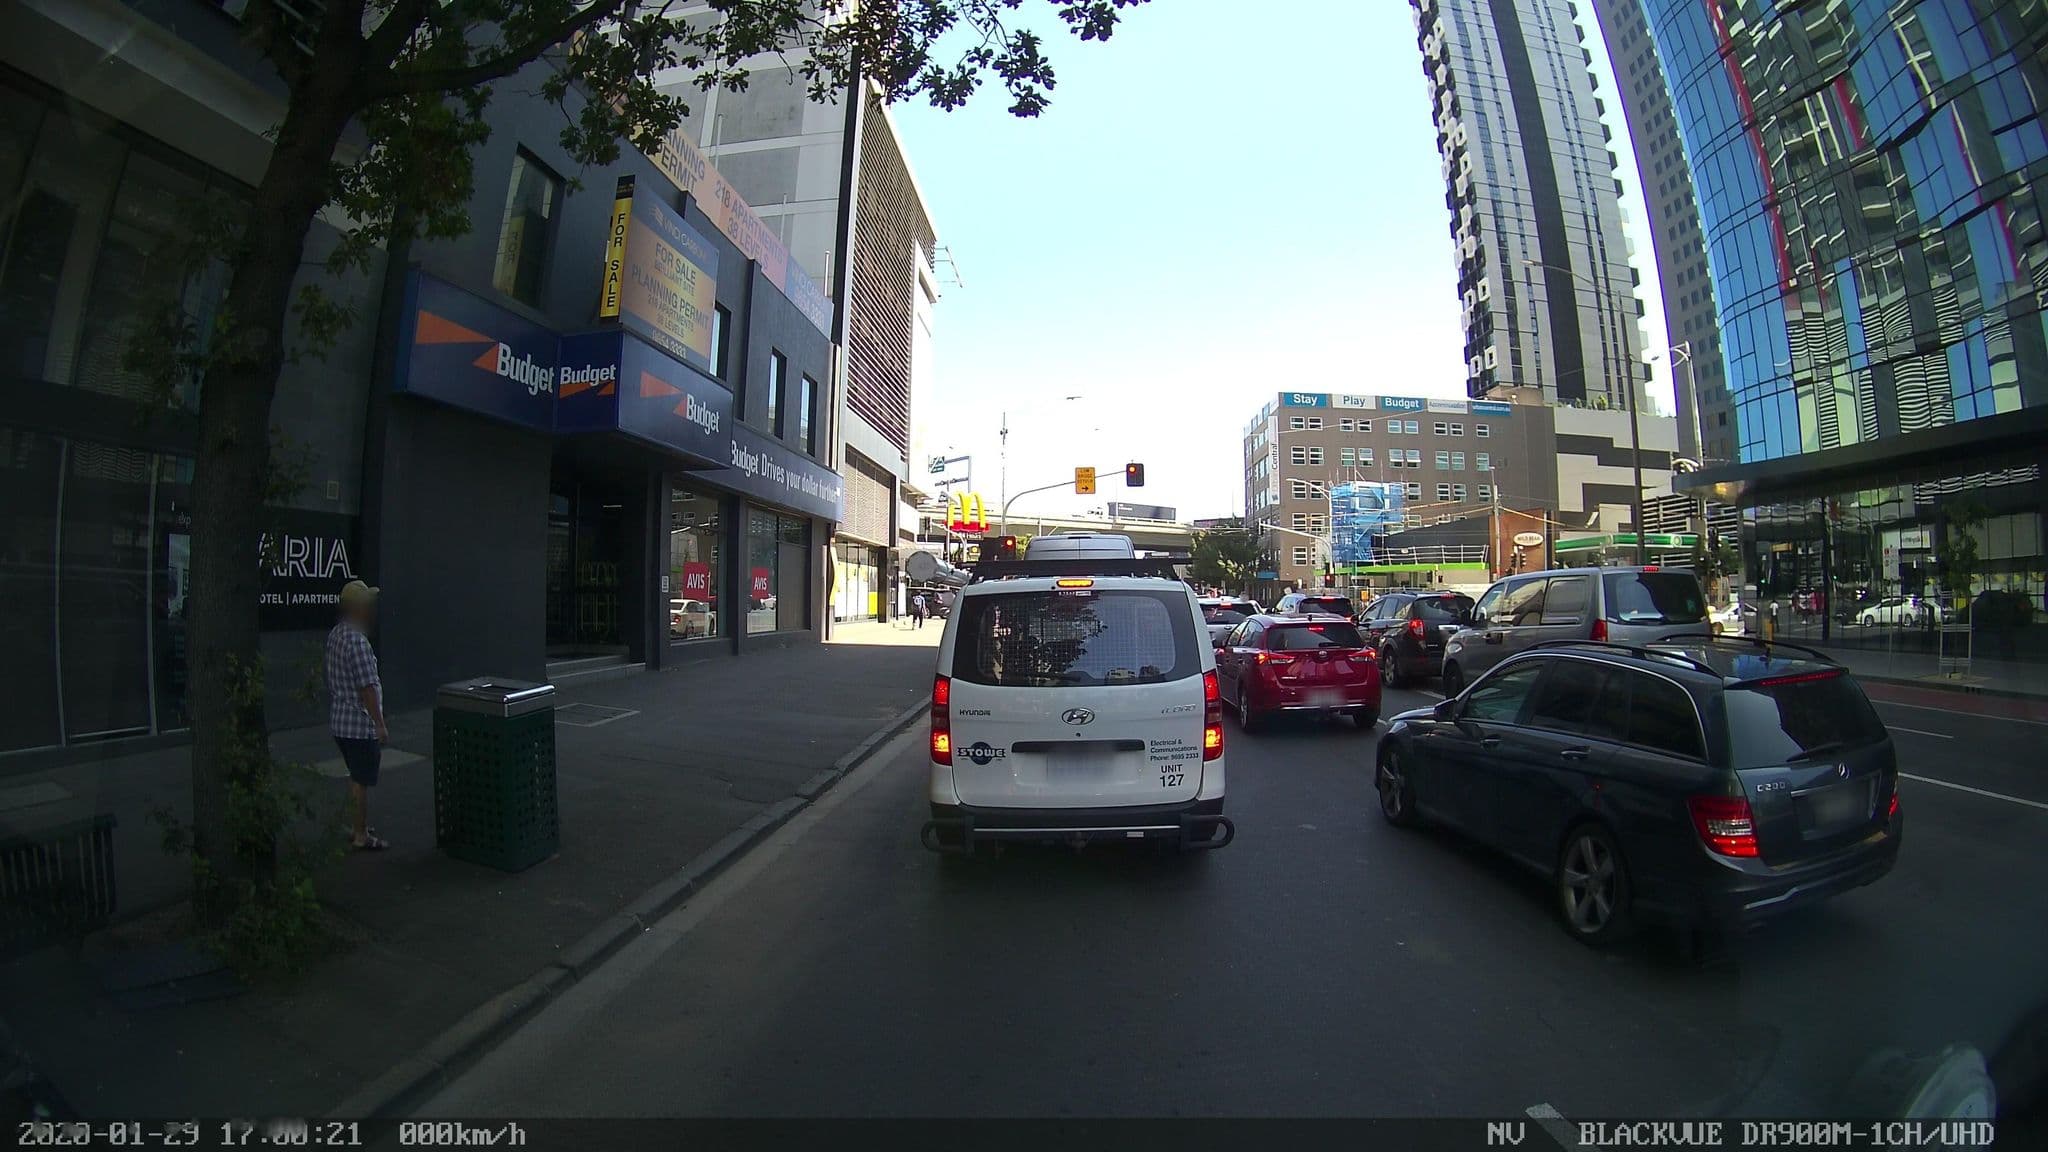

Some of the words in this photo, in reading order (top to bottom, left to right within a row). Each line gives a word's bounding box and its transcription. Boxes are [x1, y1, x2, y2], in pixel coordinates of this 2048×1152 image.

[663, 129, 706, 181] ANNING
[716, 180, 731, 209] 218
[614, 213, 626, 248] FOR
[740, 228, 769, 270] LEVELS
[656, 242, 674, 267] FOR
[675, 258, 696, 286] SALE
[607, 260, 619, 308] SALE
[632, 263, 678, 309] PLANNING
[680, 299, 709, 332] PERMIT
[496, 342, 555, 396] Budget
[560, 364, 616, 386] Budget
[687, 394, 720, 435] Budget
[1293, 394, 1318, 406] Stay
[1343, 396, 1366, 407] Play
[1385, 398, 1420, 409] Budget
[731, 440, 759, 477] Budget
[761, 453, 784, 484] Drives
[785, 470, 801, 491] your
[687, 573, 705, 590] AVIS
[754, 577, 767, 590] AVIS
[260, 593, 284, 604] OTEL
[291, 593, 340, 604] APARTMEN
[959, 747, 1004, 758] STOWE
[1150, 746, 1198, 754] Communications
[1159, 774, 1185, 788] 127
[1161, 764, 1183, 774] UNIT
